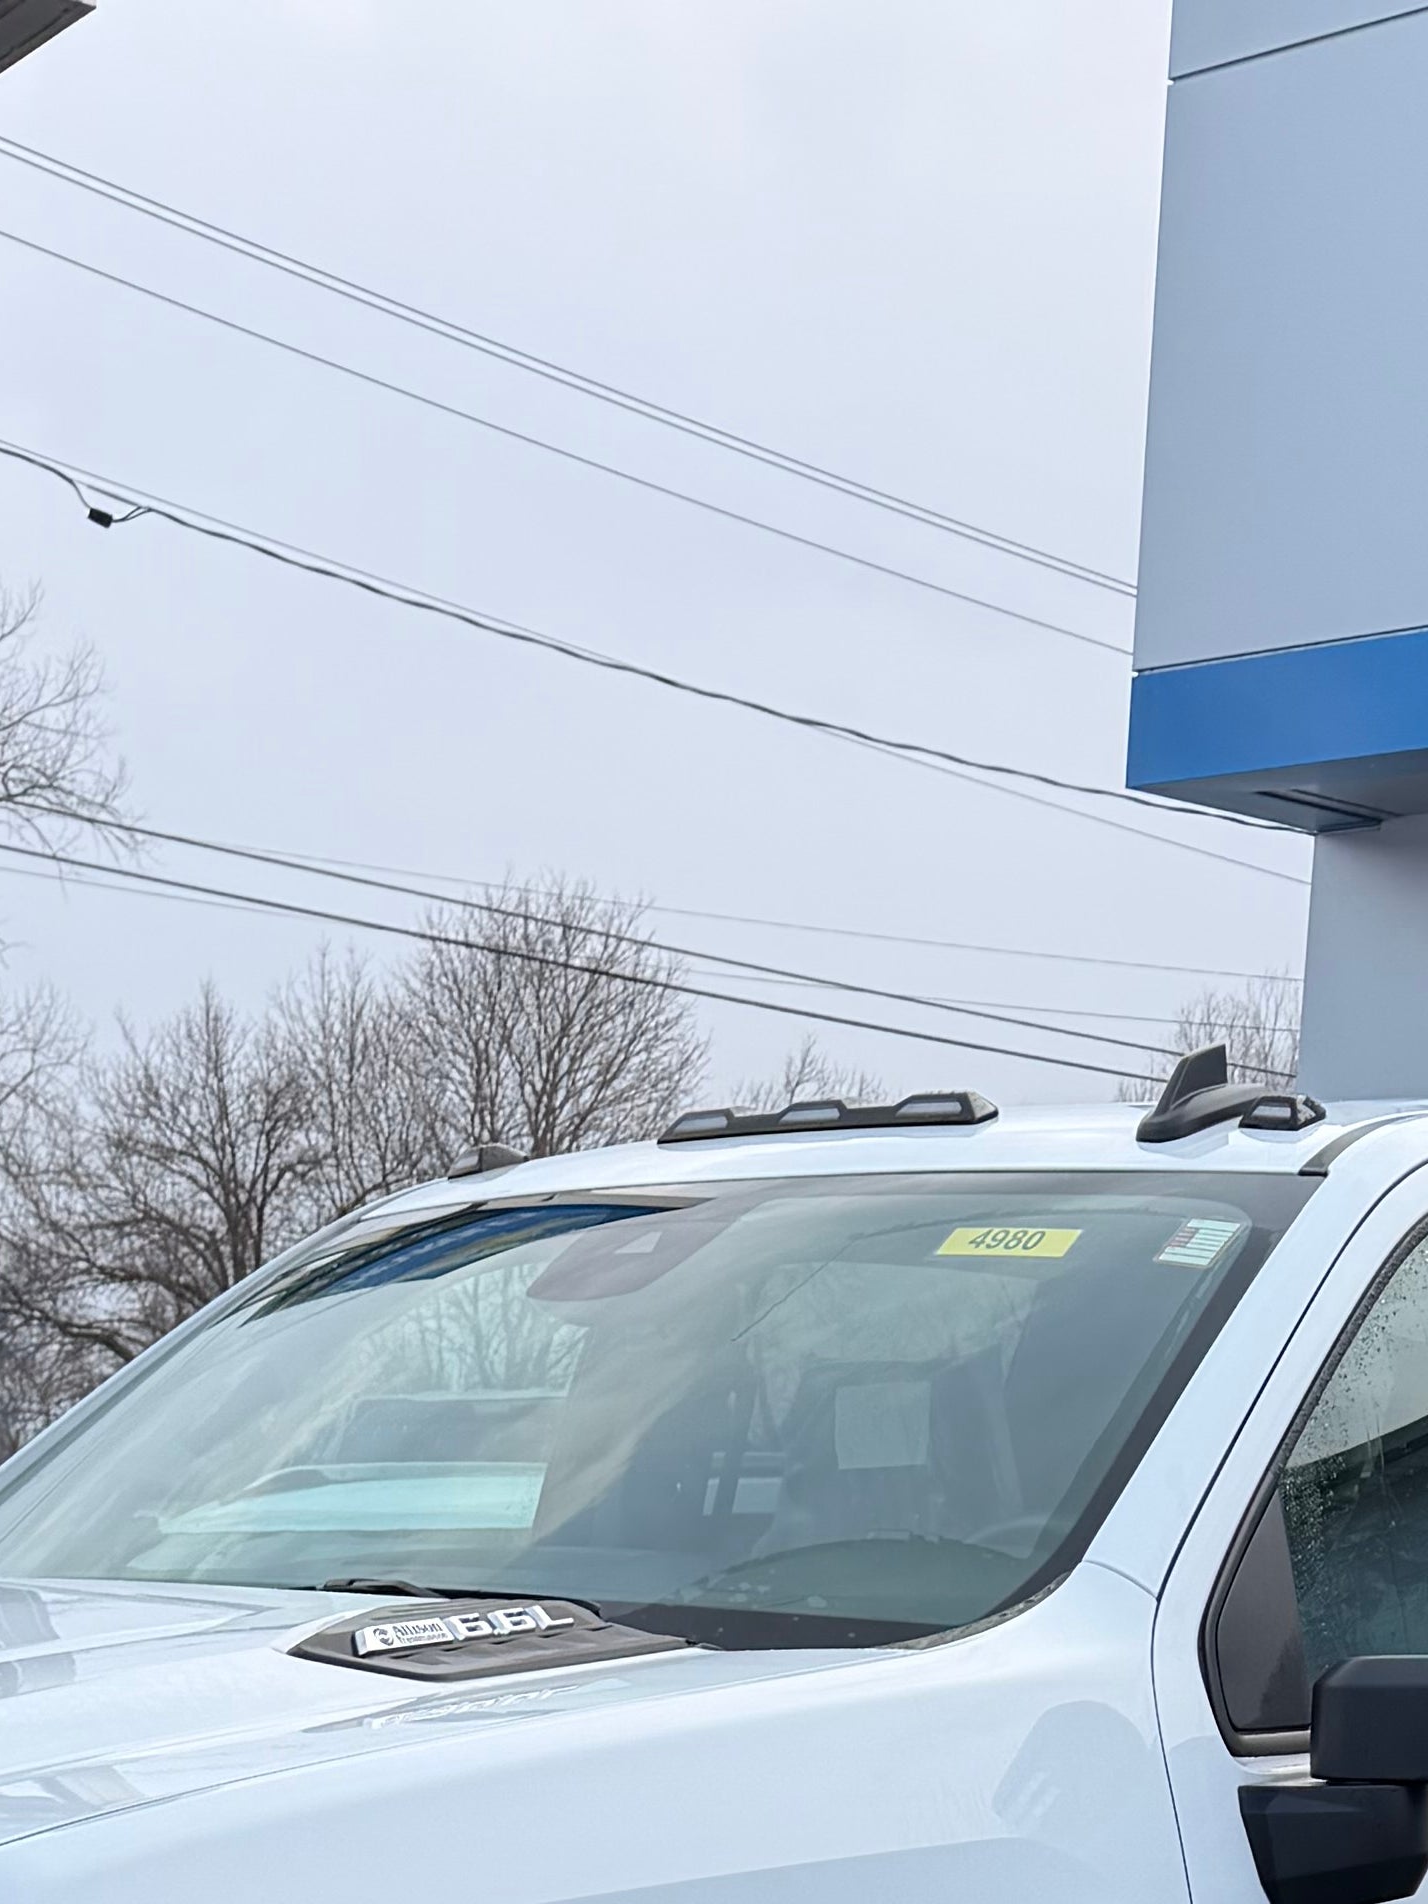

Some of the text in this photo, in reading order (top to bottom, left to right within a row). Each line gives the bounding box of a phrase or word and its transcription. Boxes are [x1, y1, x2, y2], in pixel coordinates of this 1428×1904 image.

[969, 1228, 1046, 1250] 4980
[393, 1621, 444, 1638] Allison
[442, 1605, 575, 1641] 6.6L
